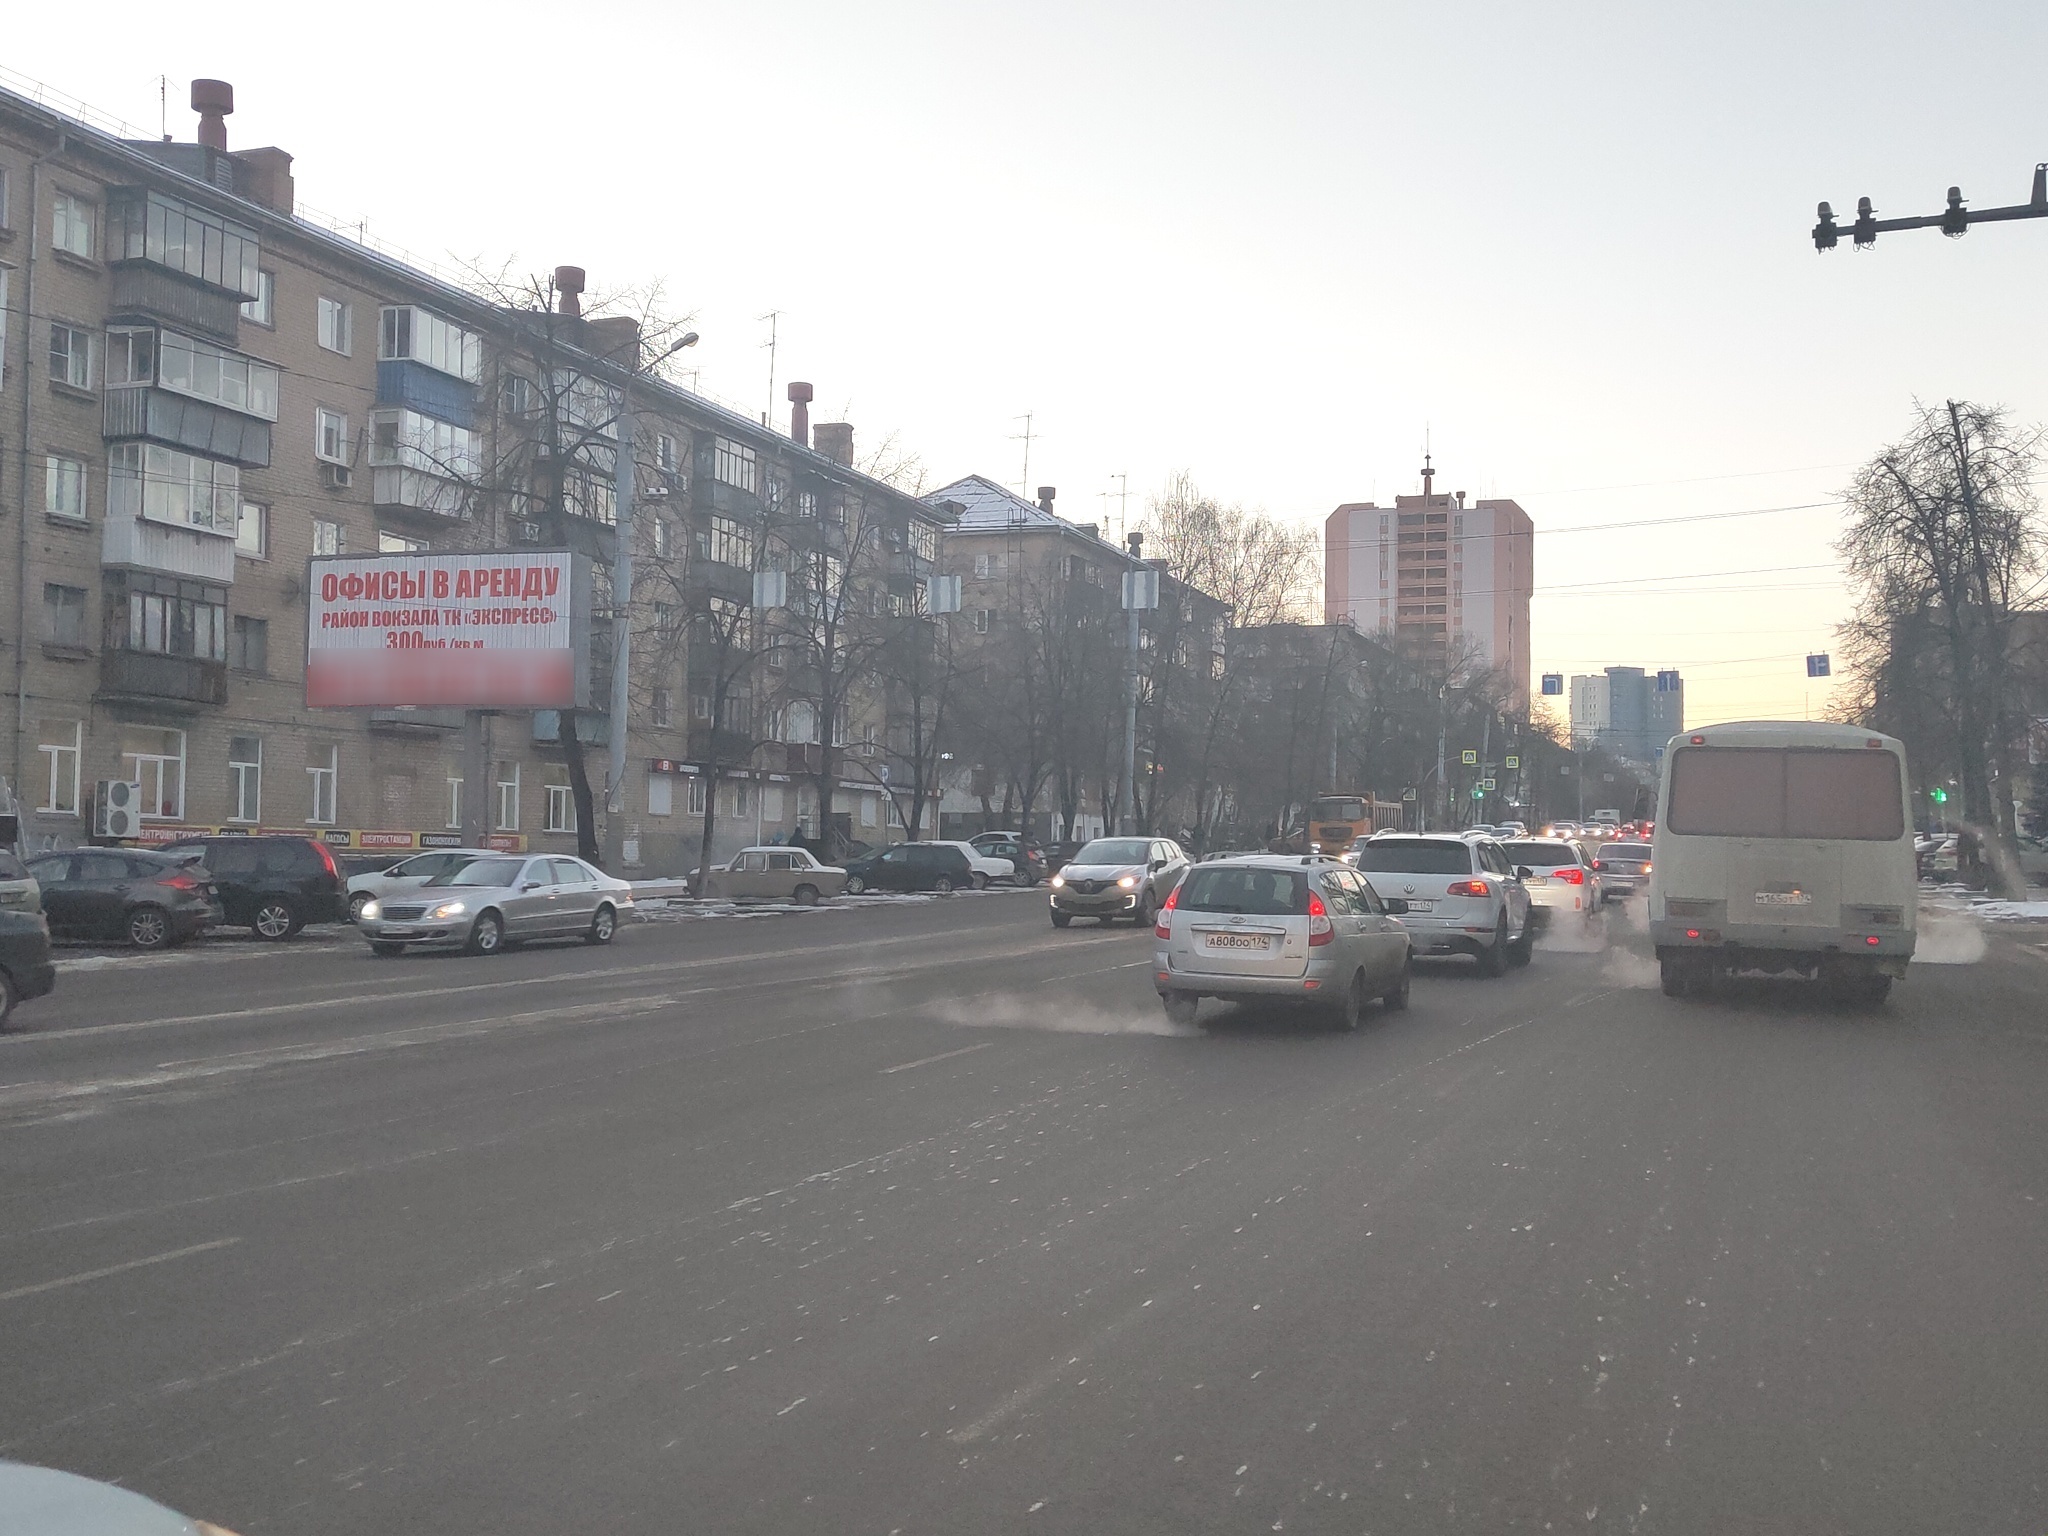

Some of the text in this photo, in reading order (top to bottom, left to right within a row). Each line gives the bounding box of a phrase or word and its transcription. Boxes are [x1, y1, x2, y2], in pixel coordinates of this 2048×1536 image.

[322, 567, 559, 602] ОФИСЫ В АРЕНДУ
[322, 606, 557, 628] РАЙОН ВОКЗАЛА ТК «ЭКСПРЕСС»
[325, 833, 350, 844] НАСОСЫ
[1209, 936, 1268, 947] А808ОО 174
